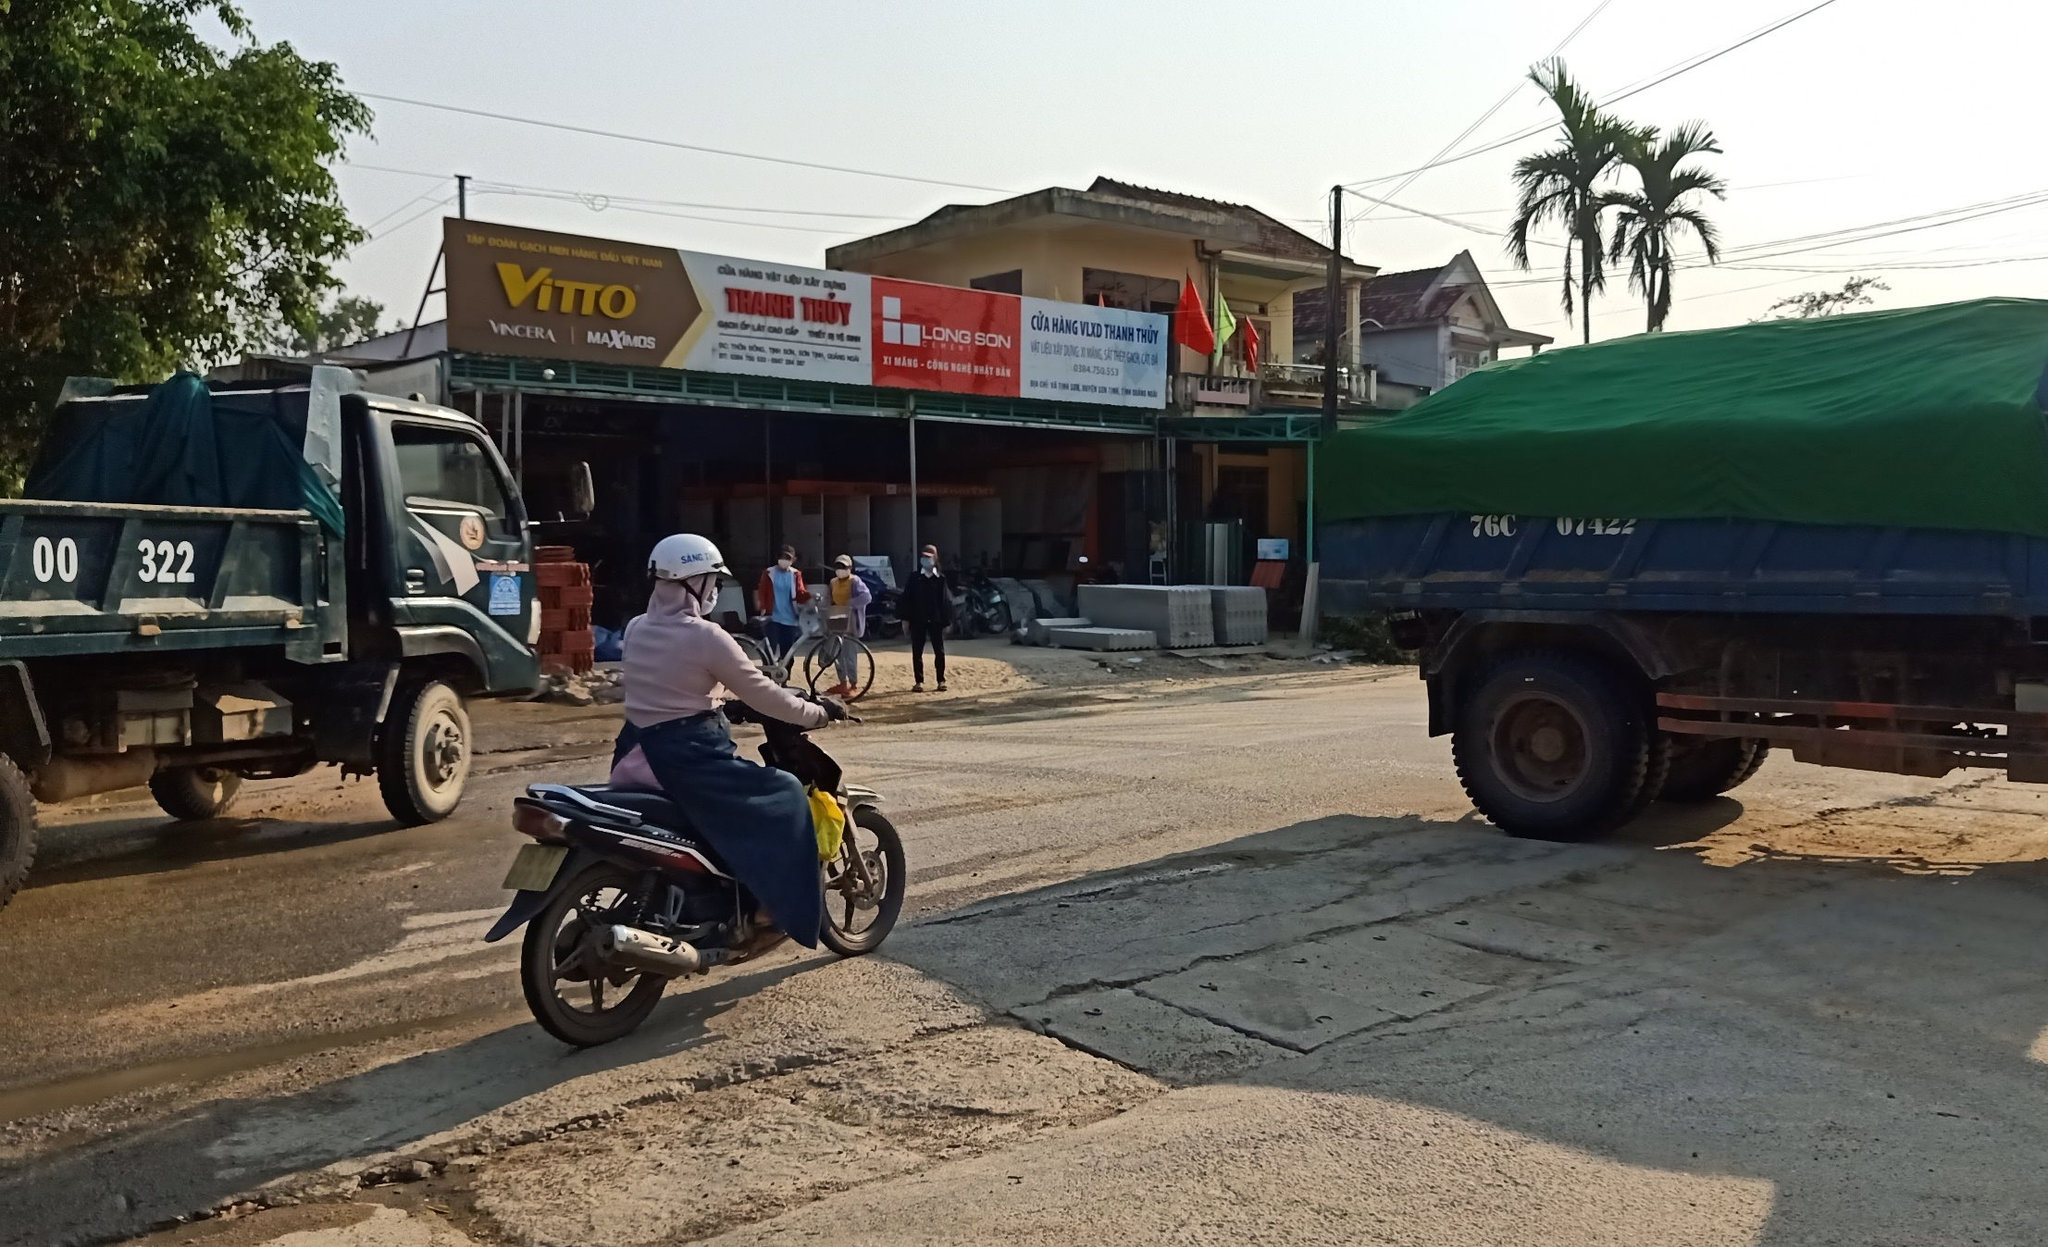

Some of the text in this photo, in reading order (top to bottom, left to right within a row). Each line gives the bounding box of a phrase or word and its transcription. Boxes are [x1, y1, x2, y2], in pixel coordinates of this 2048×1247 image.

[739, 267, 763, 280] HÀNG
[804, 277, 821, 287] XÂY
[724, 287, 852, 326] THANH THỦY
[489, 319, 557, 343] VINCERA
[922, 325, 1011, 349] LONG SON
[1031, 311, 1159, 345] CỬA HÀNG VLXD THANH THỦY
[883, 356, 892, 366] XI
[926, 359, 949, 371] CÔNG
[973, 364, 994, 377] NHẬT
[1470, 514, 1517, 538] 76C
[33, 536, 195, 583] 00 322
